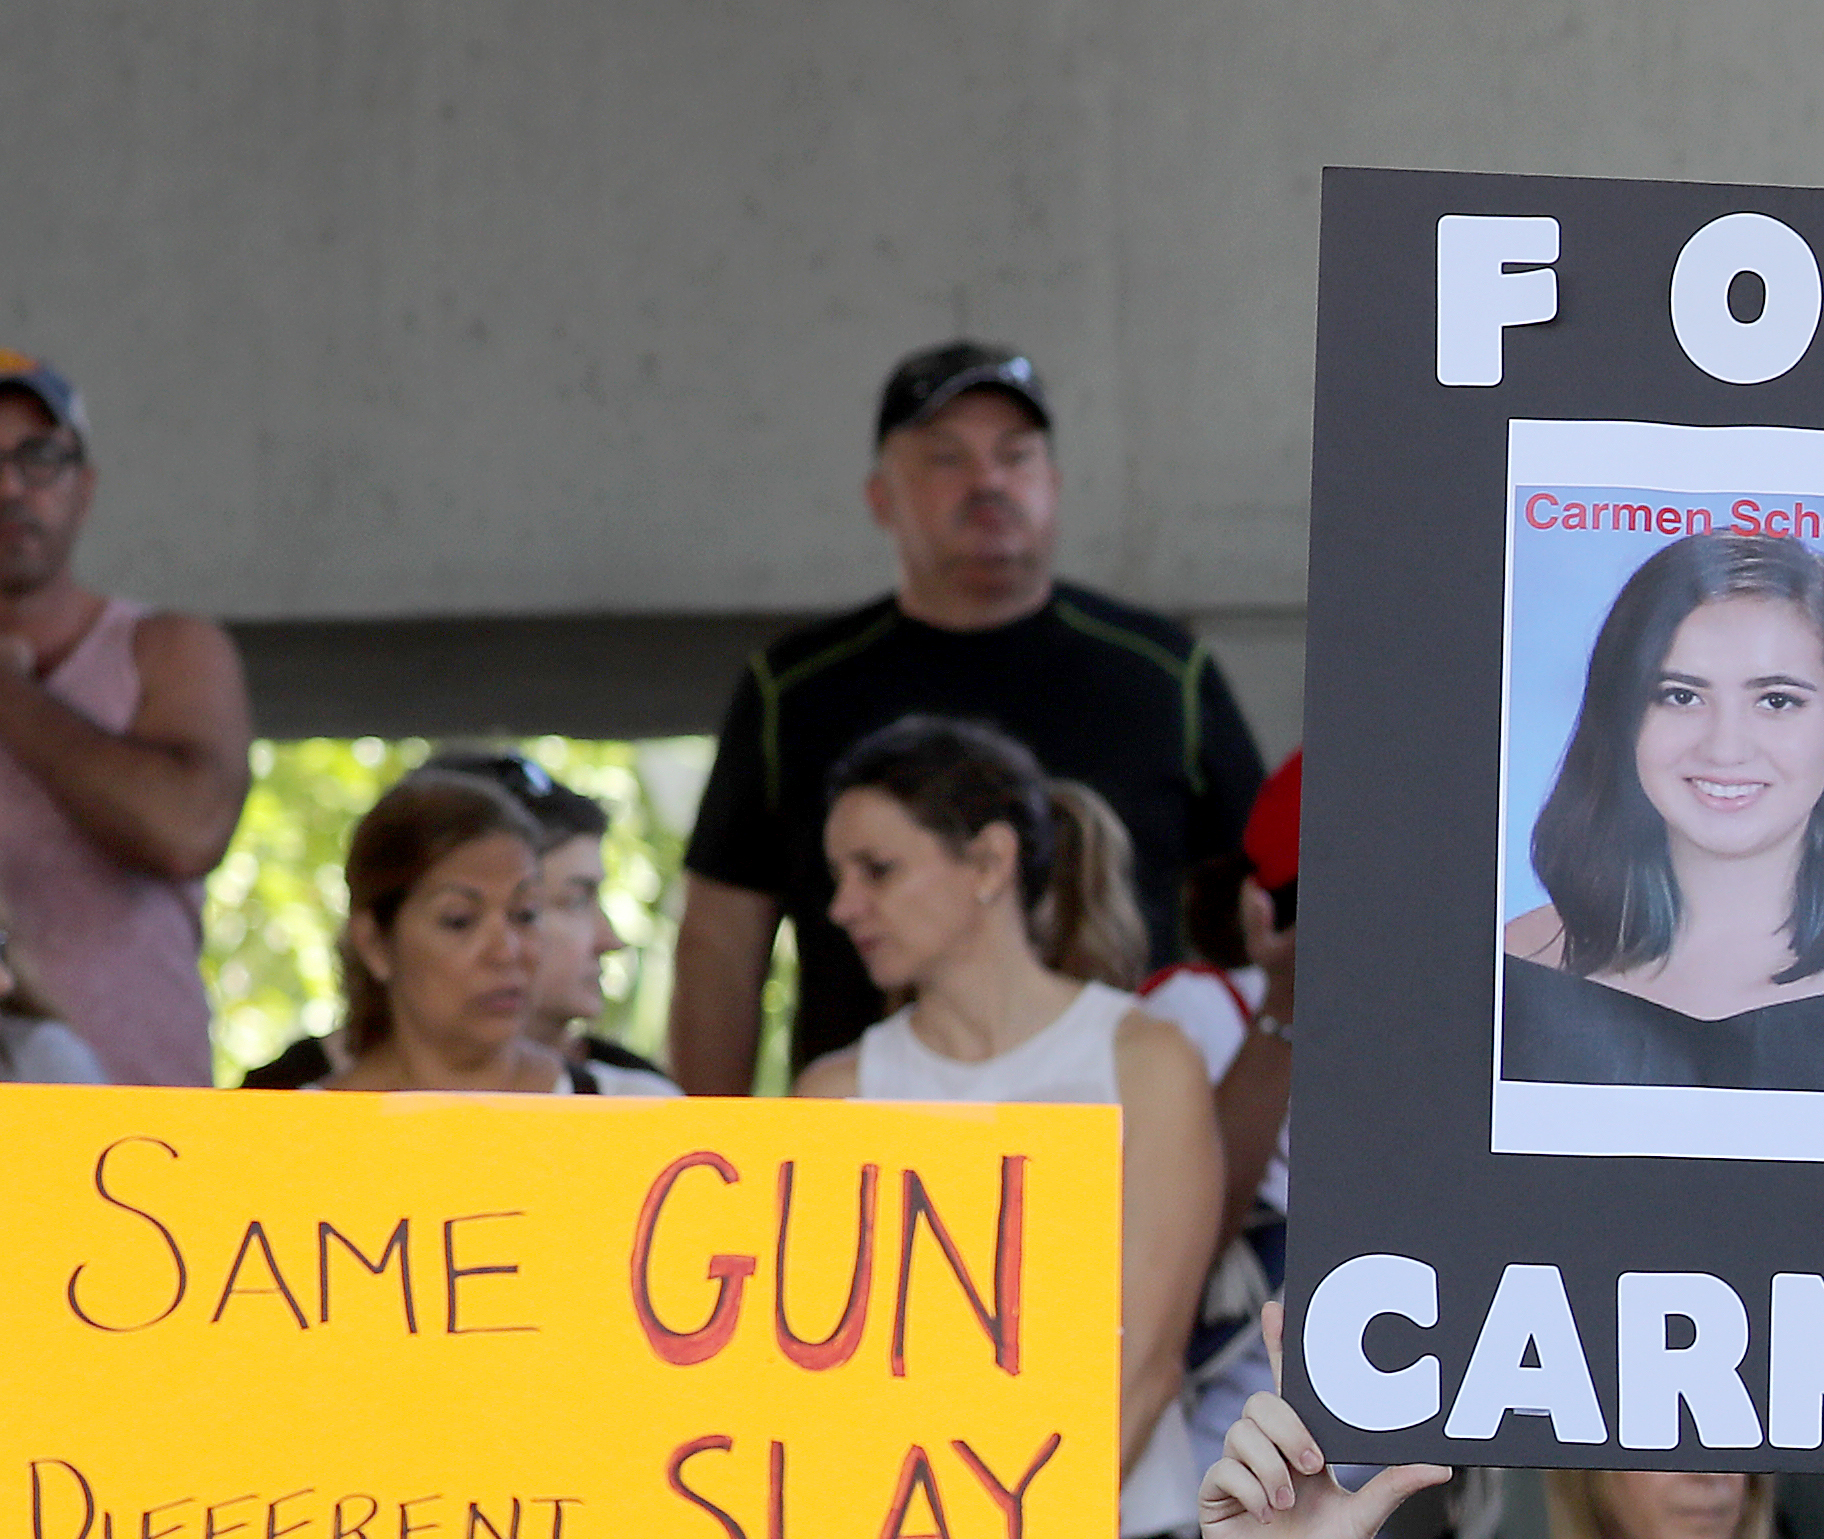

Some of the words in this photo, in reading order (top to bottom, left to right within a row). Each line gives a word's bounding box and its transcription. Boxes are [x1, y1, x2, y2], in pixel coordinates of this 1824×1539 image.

[1523, 491, 1714, 538] Carmen
[67, 1136, 540, 1334] SAME
[630, 1150, 1030, 1377] GUN
